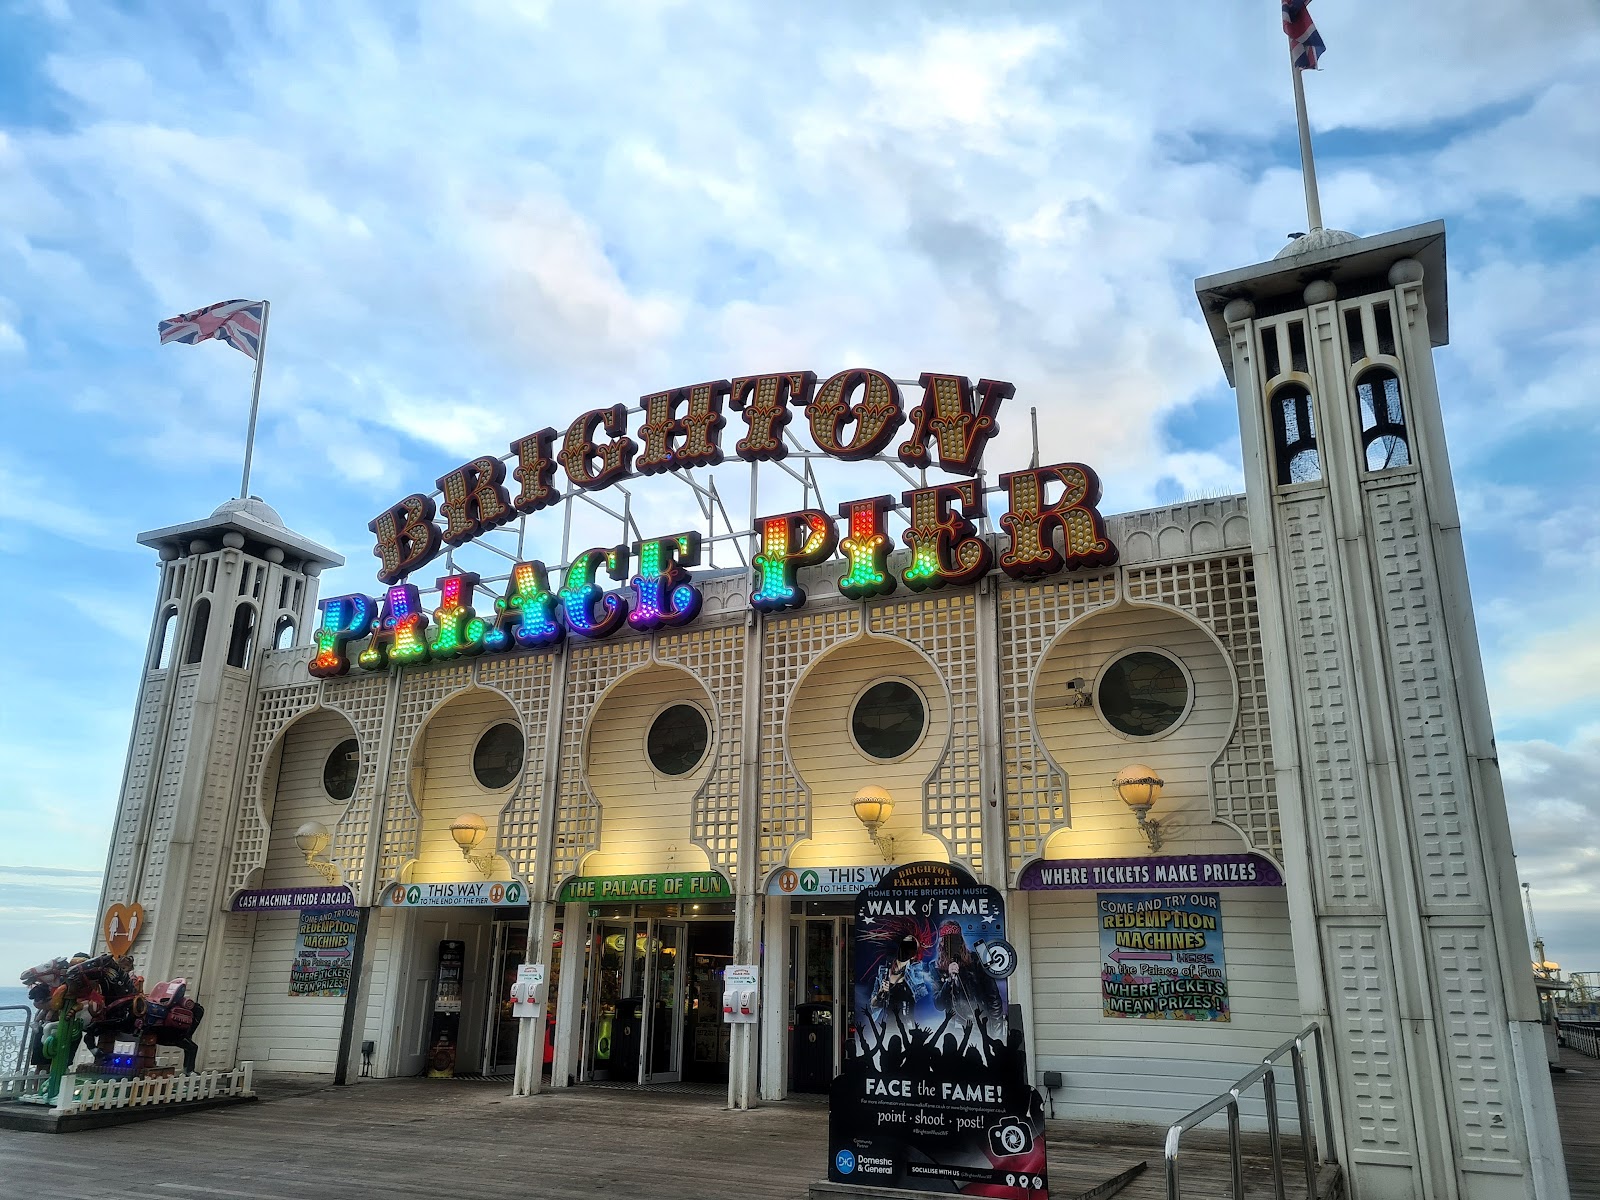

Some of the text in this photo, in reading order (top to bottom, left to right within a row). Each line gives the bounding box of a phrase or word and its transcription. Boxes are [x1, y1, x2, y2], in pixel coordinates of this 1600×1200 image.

[368, 368, 1016, 585] BRIGHTON
[308, 462, 1118, 677] PALACE PIER
[829, 868, 865, 882] THIS
[898, 866, 951, 878] BRIGHTON
[1040, 862, 1256, 885] WHERE TICKETS MAKE PRIZES
[568, 876, 722, 898] THE PALACE OF FUN
[894, 876, 958, 886] PALACE PIER
[428, 884, 483, 896] THIS WAY
[921, 888, 960, 896] BRIGHTON
[240, 892, 351, 908] CASH MACHINE INSIDE ARCADE
[1101, 894, 1217, 914] COME AND TRY OUR
[867, 898, 988, 918] WALK of FAME
[301, 909, 360, 923] COME AND TRY OUR
[1104, 910, 1216, 930] REDEMPTION
[300, 920, 356, 934] REDEMPTION
[304, 935, 348, 948] MACHINES
[1116, 931, 1205, 950] MACHINES
[1177, 953, 1214, 964] HERE
[292, 968, 350, 981] WHERE TICKETS
[1104, 963, 1222, 977] In the Palace of Fun
[292, 982, 315, 992] MEAN
[1104, 980, 1225, 998] WHERE TICKETS
[1110, 998, 1154, 1012] MEAN
[866, 1078, 1002, 1103] FACE the FAME!
[878, 1108, 984, 1132] point shoot post!
[858, 1154, 892, 1166] Domestic
[858, 1164, 892, 1174] & General
[912, 1166, 938, 1175] SOCIALISE
[939, 1168, 952, 1176] WITH
